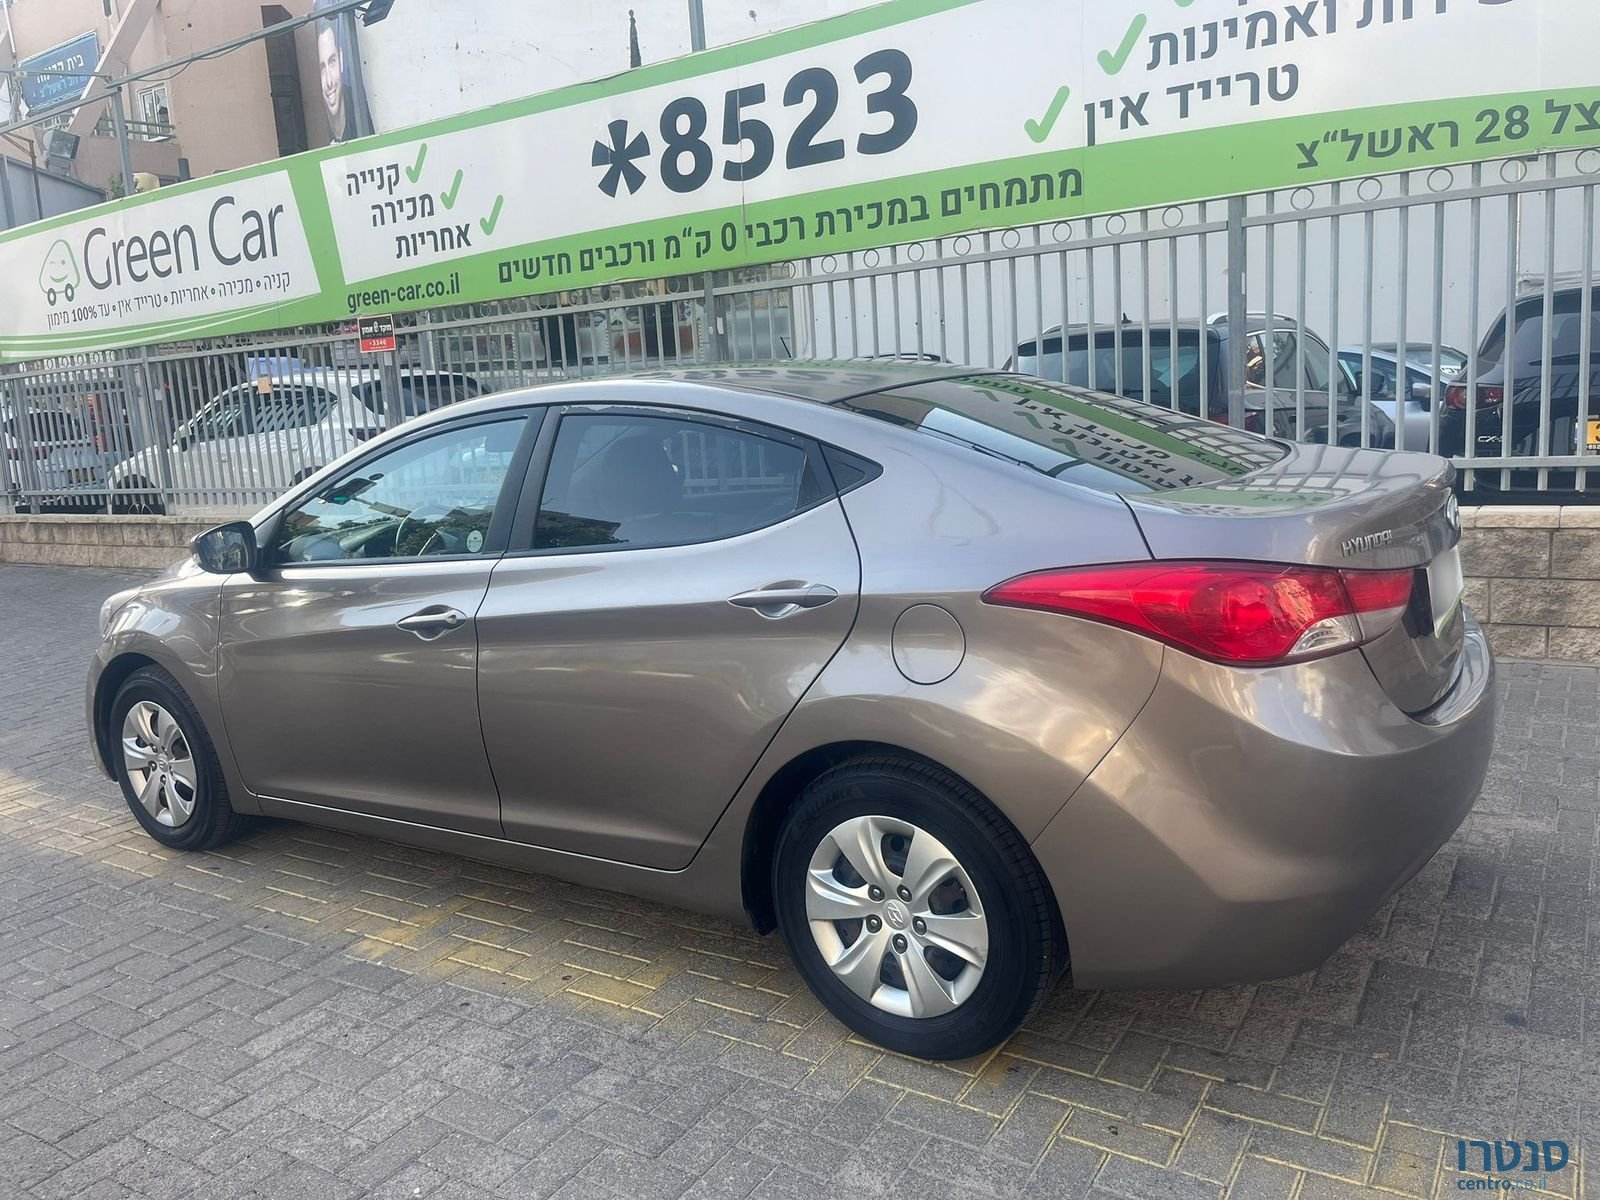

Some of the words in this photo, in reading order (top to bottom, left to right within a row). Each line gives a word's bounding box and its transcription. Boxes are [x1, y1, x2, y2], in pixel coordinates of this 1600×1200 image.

[1146, 0, 1338, 71] ואמינות
[1166, 63, 1300, 119] טרייד
[1084, 91, 1150, 147] אין
[1475, 104, 1530, 144] 28
[346, 163, 401, 196] קנייה
[941, 168, 1083, 217] מתמחים
[371, 193, 435, 227] מכירה
[814, 194, 930, 238] במכירת
[84, 224, 200, 290] Green
[208, 195, 284, 266] Car
[396, 223, 472, 259] אחריות
[720, 222, 737, 252] 0
[745, 215, 805, 247] רכבי
[498, 252, 572, 284] חדשים
[579, 239, 655, 272] ורכבים
[170, 285, 209, 305] אחריות
[218, 278, 254, 297] מכירה
[263, 272, 291, 292] קניה
[347, 272, 460, 313] green-car.co.il
[71, 305, 98, 322] 100%
[97, 303, 110, 317] עד
[117, 299, 132, 318] אין
[133, 294, 161, 311] טרייד
[47, 310, 70, 330] מימון
[1477, 435, 1503, 443] CX-
[1341, 529, 1393, 554] HYUNDAI
